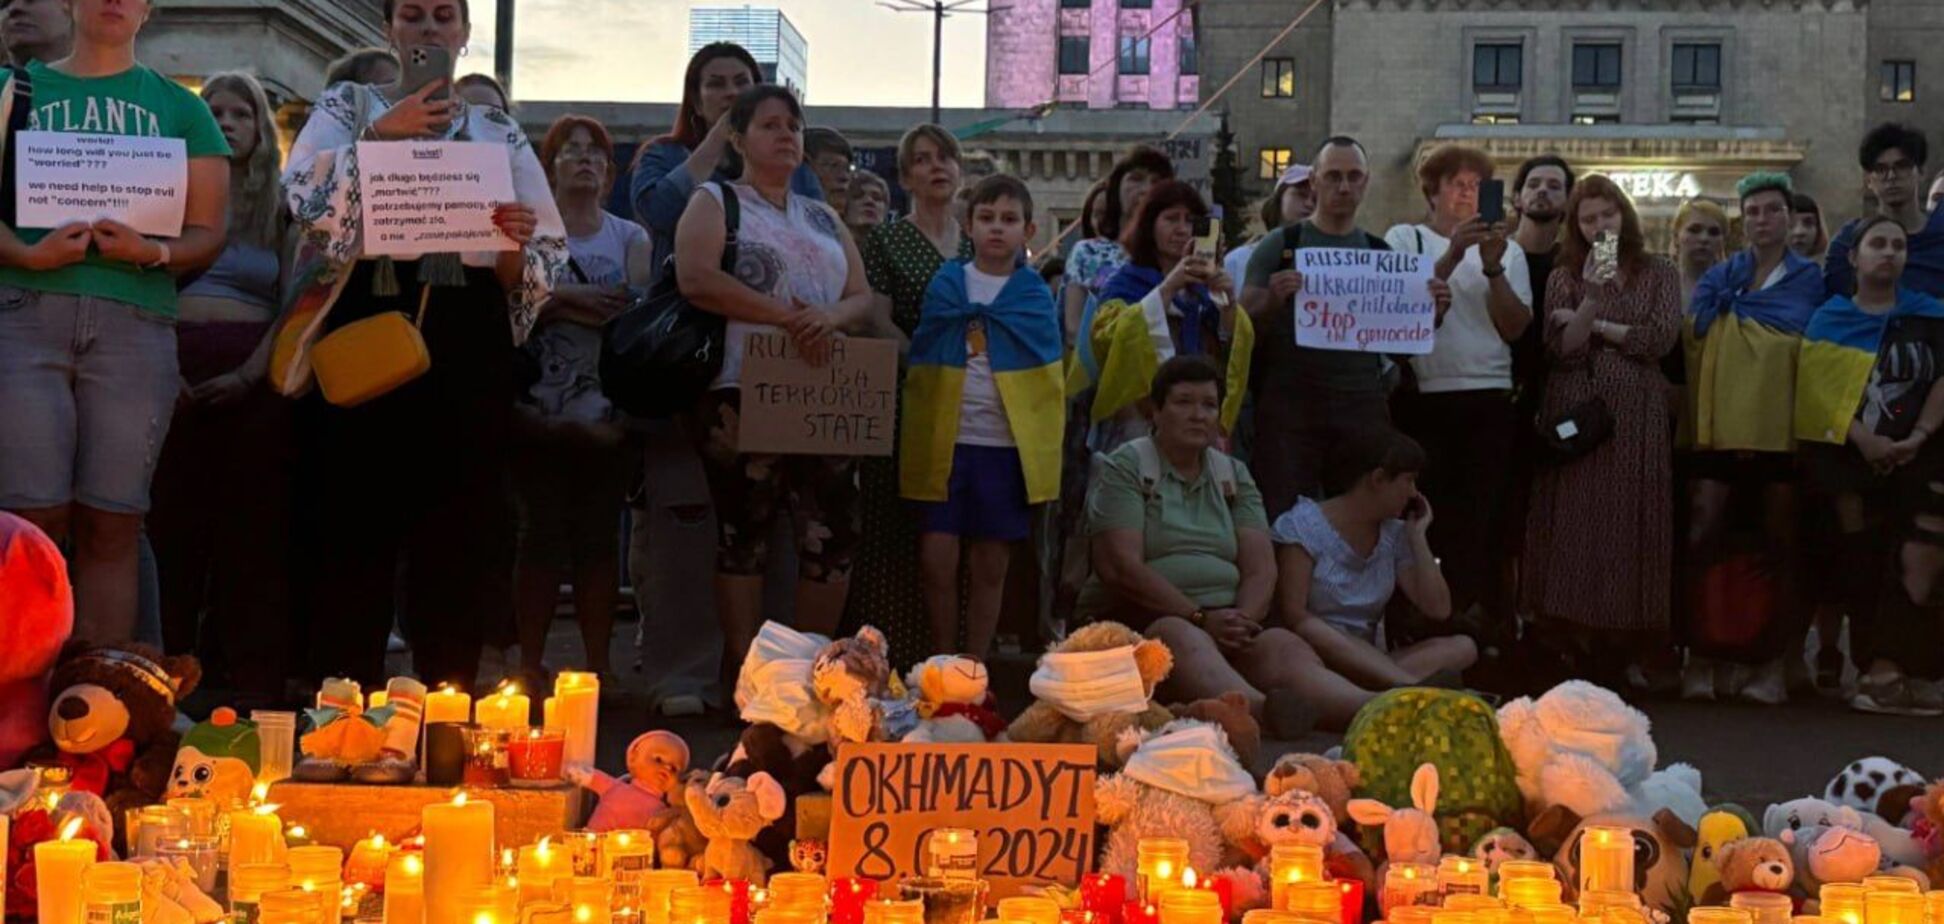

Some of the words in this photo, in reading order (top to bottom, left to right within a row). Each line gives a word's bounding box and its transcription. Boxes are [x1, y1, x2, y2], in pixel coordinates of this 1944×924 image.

[28, 96, 161, 137] ATLANTA
[28, 146, 53, 154] how
[56, 146, 83, 157] long
[86, 147, 105, 156] will
[108, 149, 130, 159] you
[131, 150, 154, 160] just
[157, 151, 172, 160] be
[370, 173, 384, 183] jak
[465, 172, 480, 183] się
[29, 181, 46, 190] we
[48, 181, 79, 191] need
[82, 182, 108, 194] help
[111, 184, 122, 193] to
[125, 184, 152, 196] stop
[154, 187, 175, 198] evil
[28, 196, 48, 205] not
[372, 201, 442, 213] potrzebujemy
[373, 215, 427, 226] zatrzymać
[380, 233, 387, 241] a
[389, 232, 405, 241] nie
[1299, 300, 1356, 341] Stop
[855, 369, 868, 388] A
[755, 382, 891, 410] TERRORIST
[803, 413, 881, 443] STATE
[841, 752, 1095, 821] OKHMADYT
